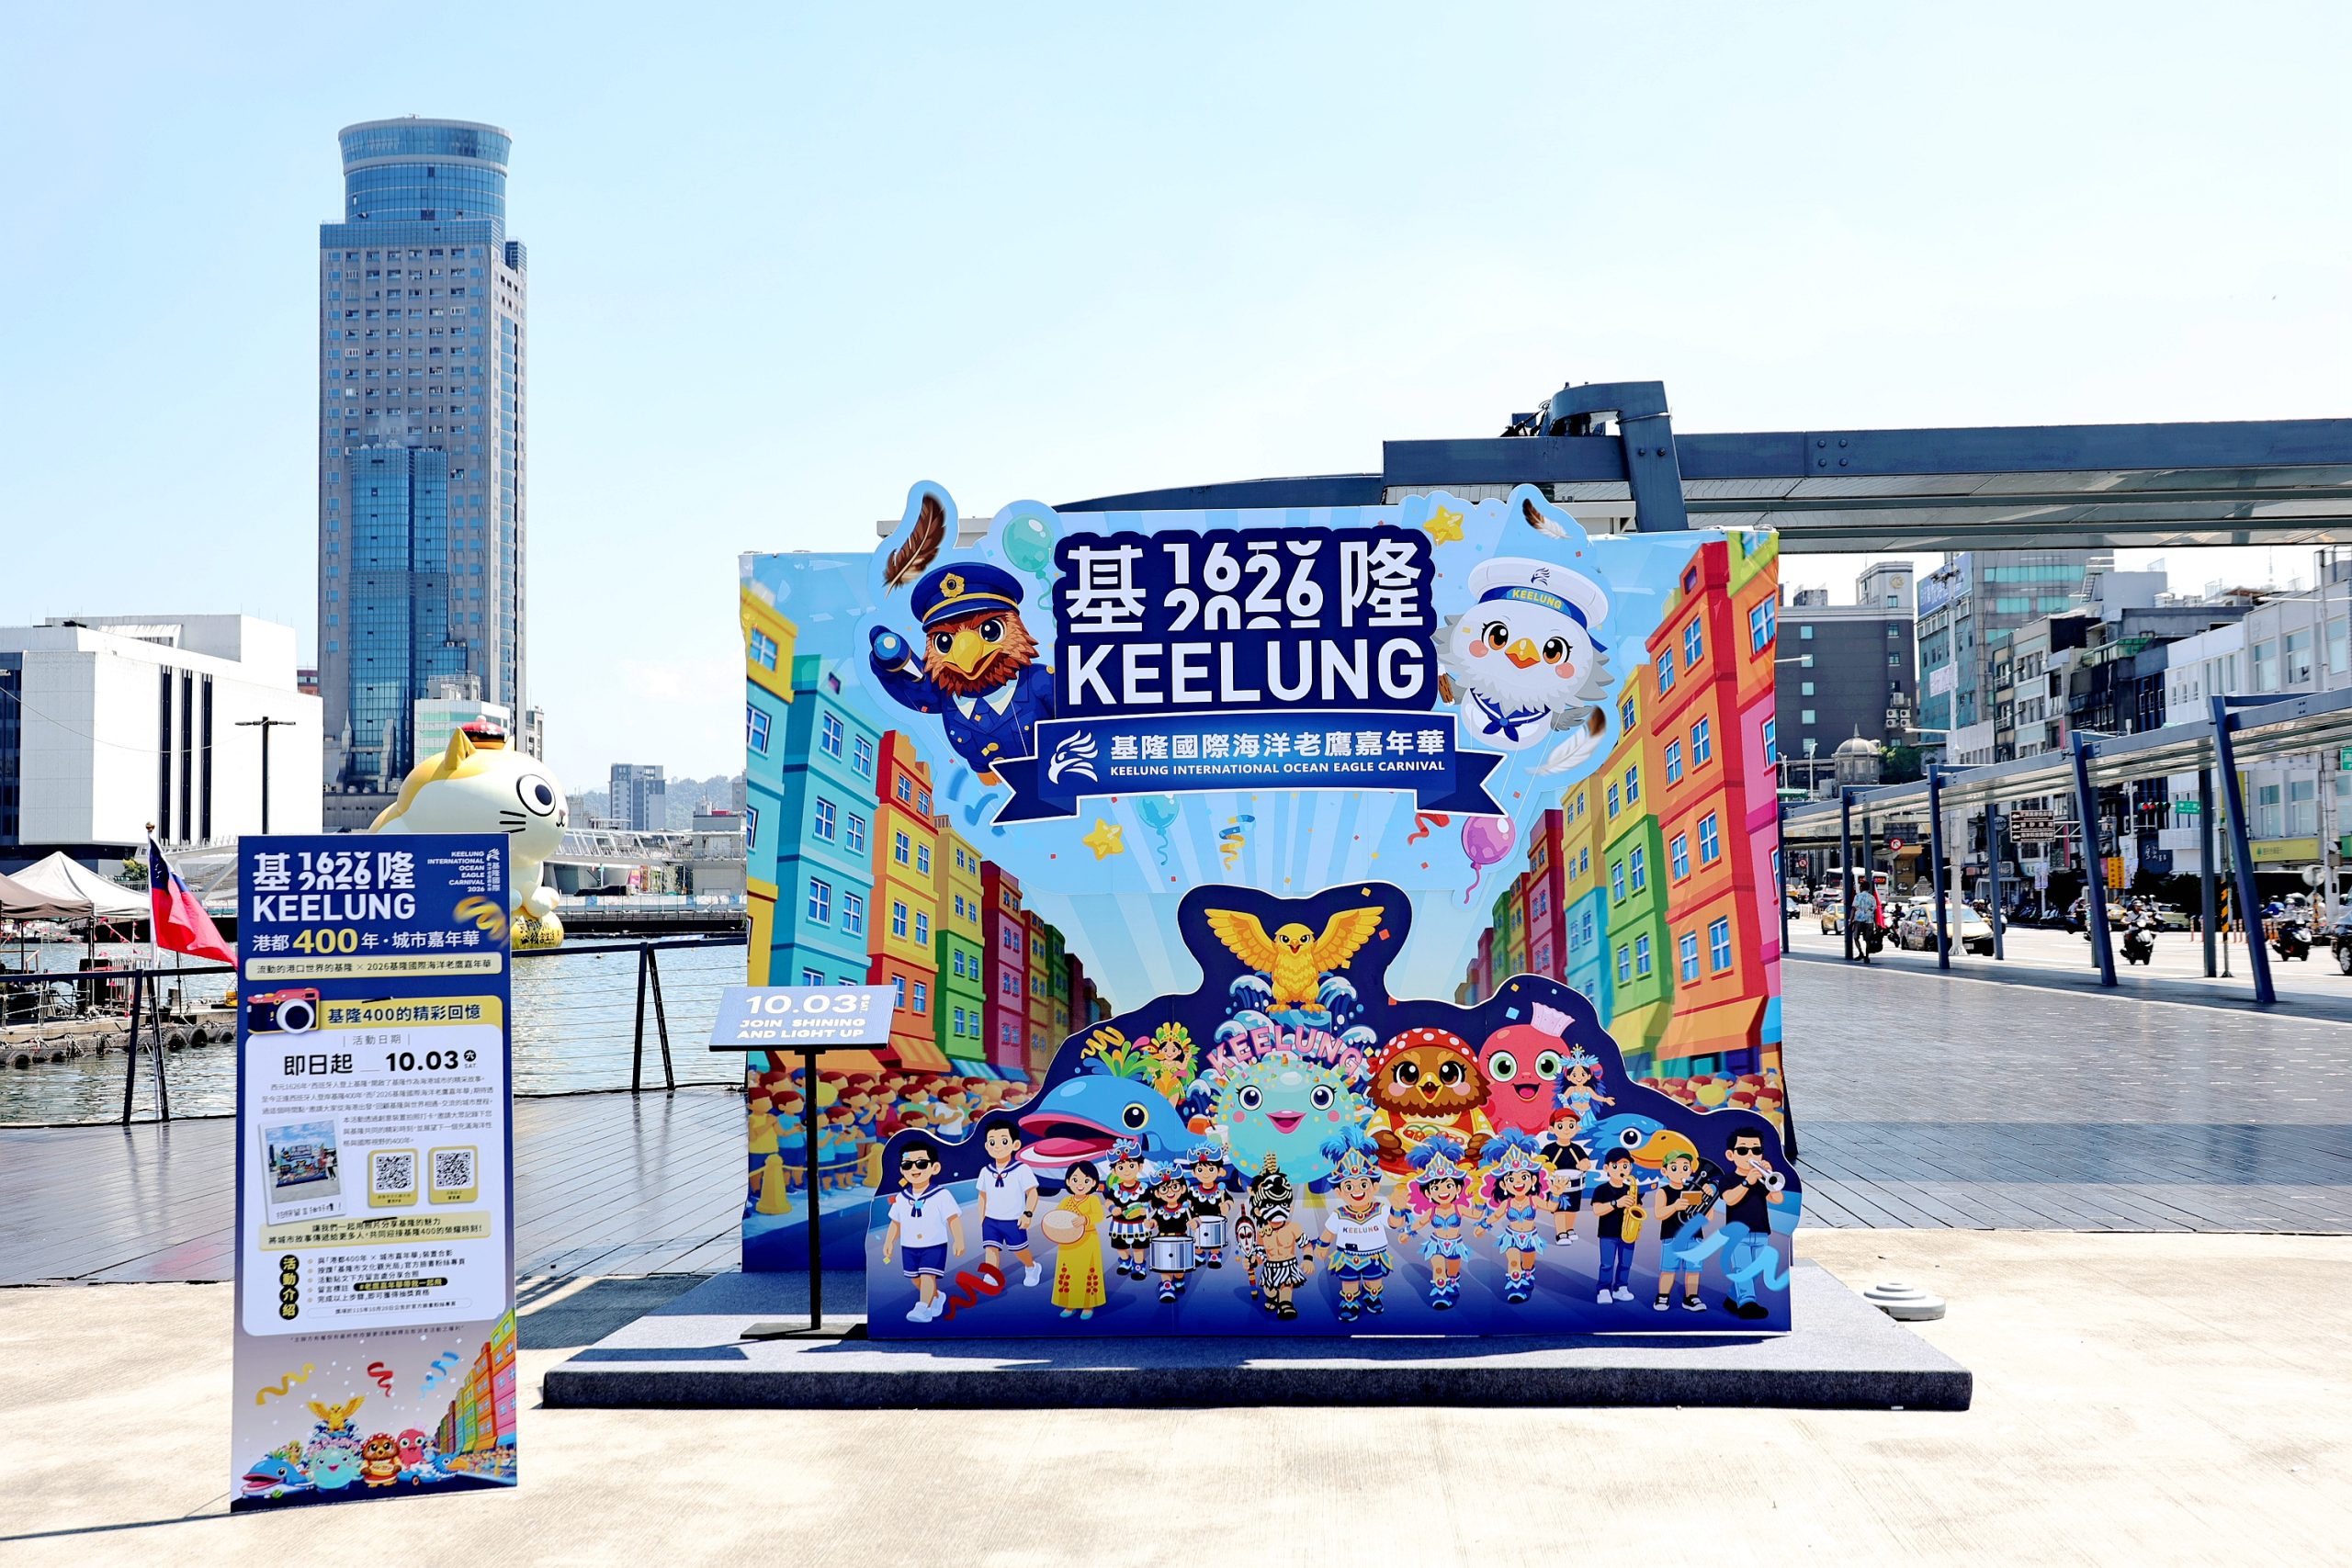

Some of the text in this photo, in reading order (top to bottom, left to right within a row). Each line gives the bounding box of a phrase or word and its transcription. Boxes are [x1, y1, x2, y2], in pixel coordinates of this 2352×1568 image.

[1065, 545, 1147, 634] 基
[1340, 538, 1423, 627] 隆
[1512, 590, 1562, 609] KEELUNG
[1068, 637, 1424, 705] KEELUNG
[1111, 729, 1445, 761] 基隆國際海洋老鷹嘉年華
[1110, 760, 1445, 776] KEELUNG INTERNATIONAL OCEAN EAGLE CARNIVAL
[253, 893, 415, 922] KEELUNG
[256, 963, 353, 975] 流動的港口世界的基隆
[367, 959, 492, 971] 2026基隆國際海洋老鷹嘉年華
[327, 1003, 481, 1024] 基隆400的精彩回憶
[745, 995, 857, 1014] 10.03
[740, 1019, 866, 1028] JOIN SHINING
[352, 1034, 401, 1045] 活動日期
[737, 1029, 865, 1039] AND LIGHT UP
[1206, 1025, 1363, 1077] KEELUNG
[283, 1054, 354, 1077] 即日起
[385, 1051, 459, 1072] 10.03
[1343, 1225, 1379, 1234] KEELUNG
[282, 1257, 297, 1317] 活動介紹
